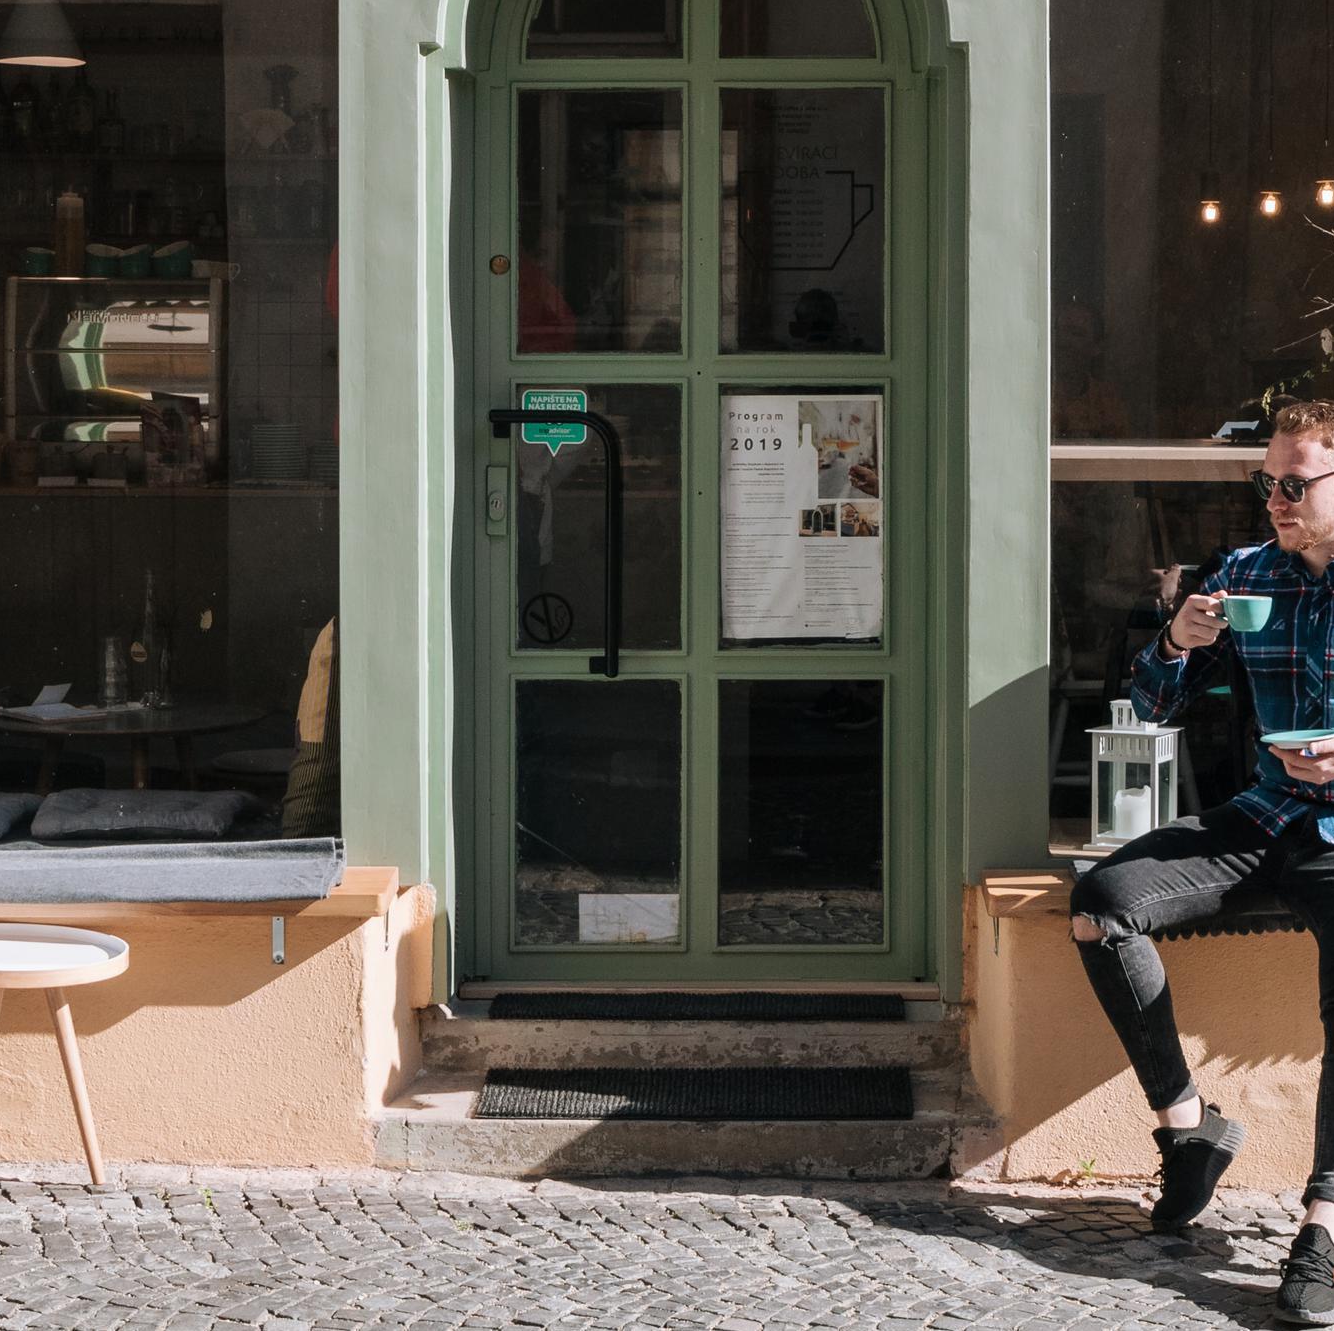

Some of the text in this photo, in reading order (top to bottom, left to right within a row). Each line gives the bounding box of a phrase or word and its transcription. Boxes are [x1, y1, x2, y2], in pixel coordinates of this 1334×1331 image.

[530, 394, 579, 404] NAPIŠTE NA
[528, 401, 545, 411] NÁS
[728, 411, 784, 423] Program
[737, 423, 777, 435] na rok
[729, 437, 783, 452] 2019
